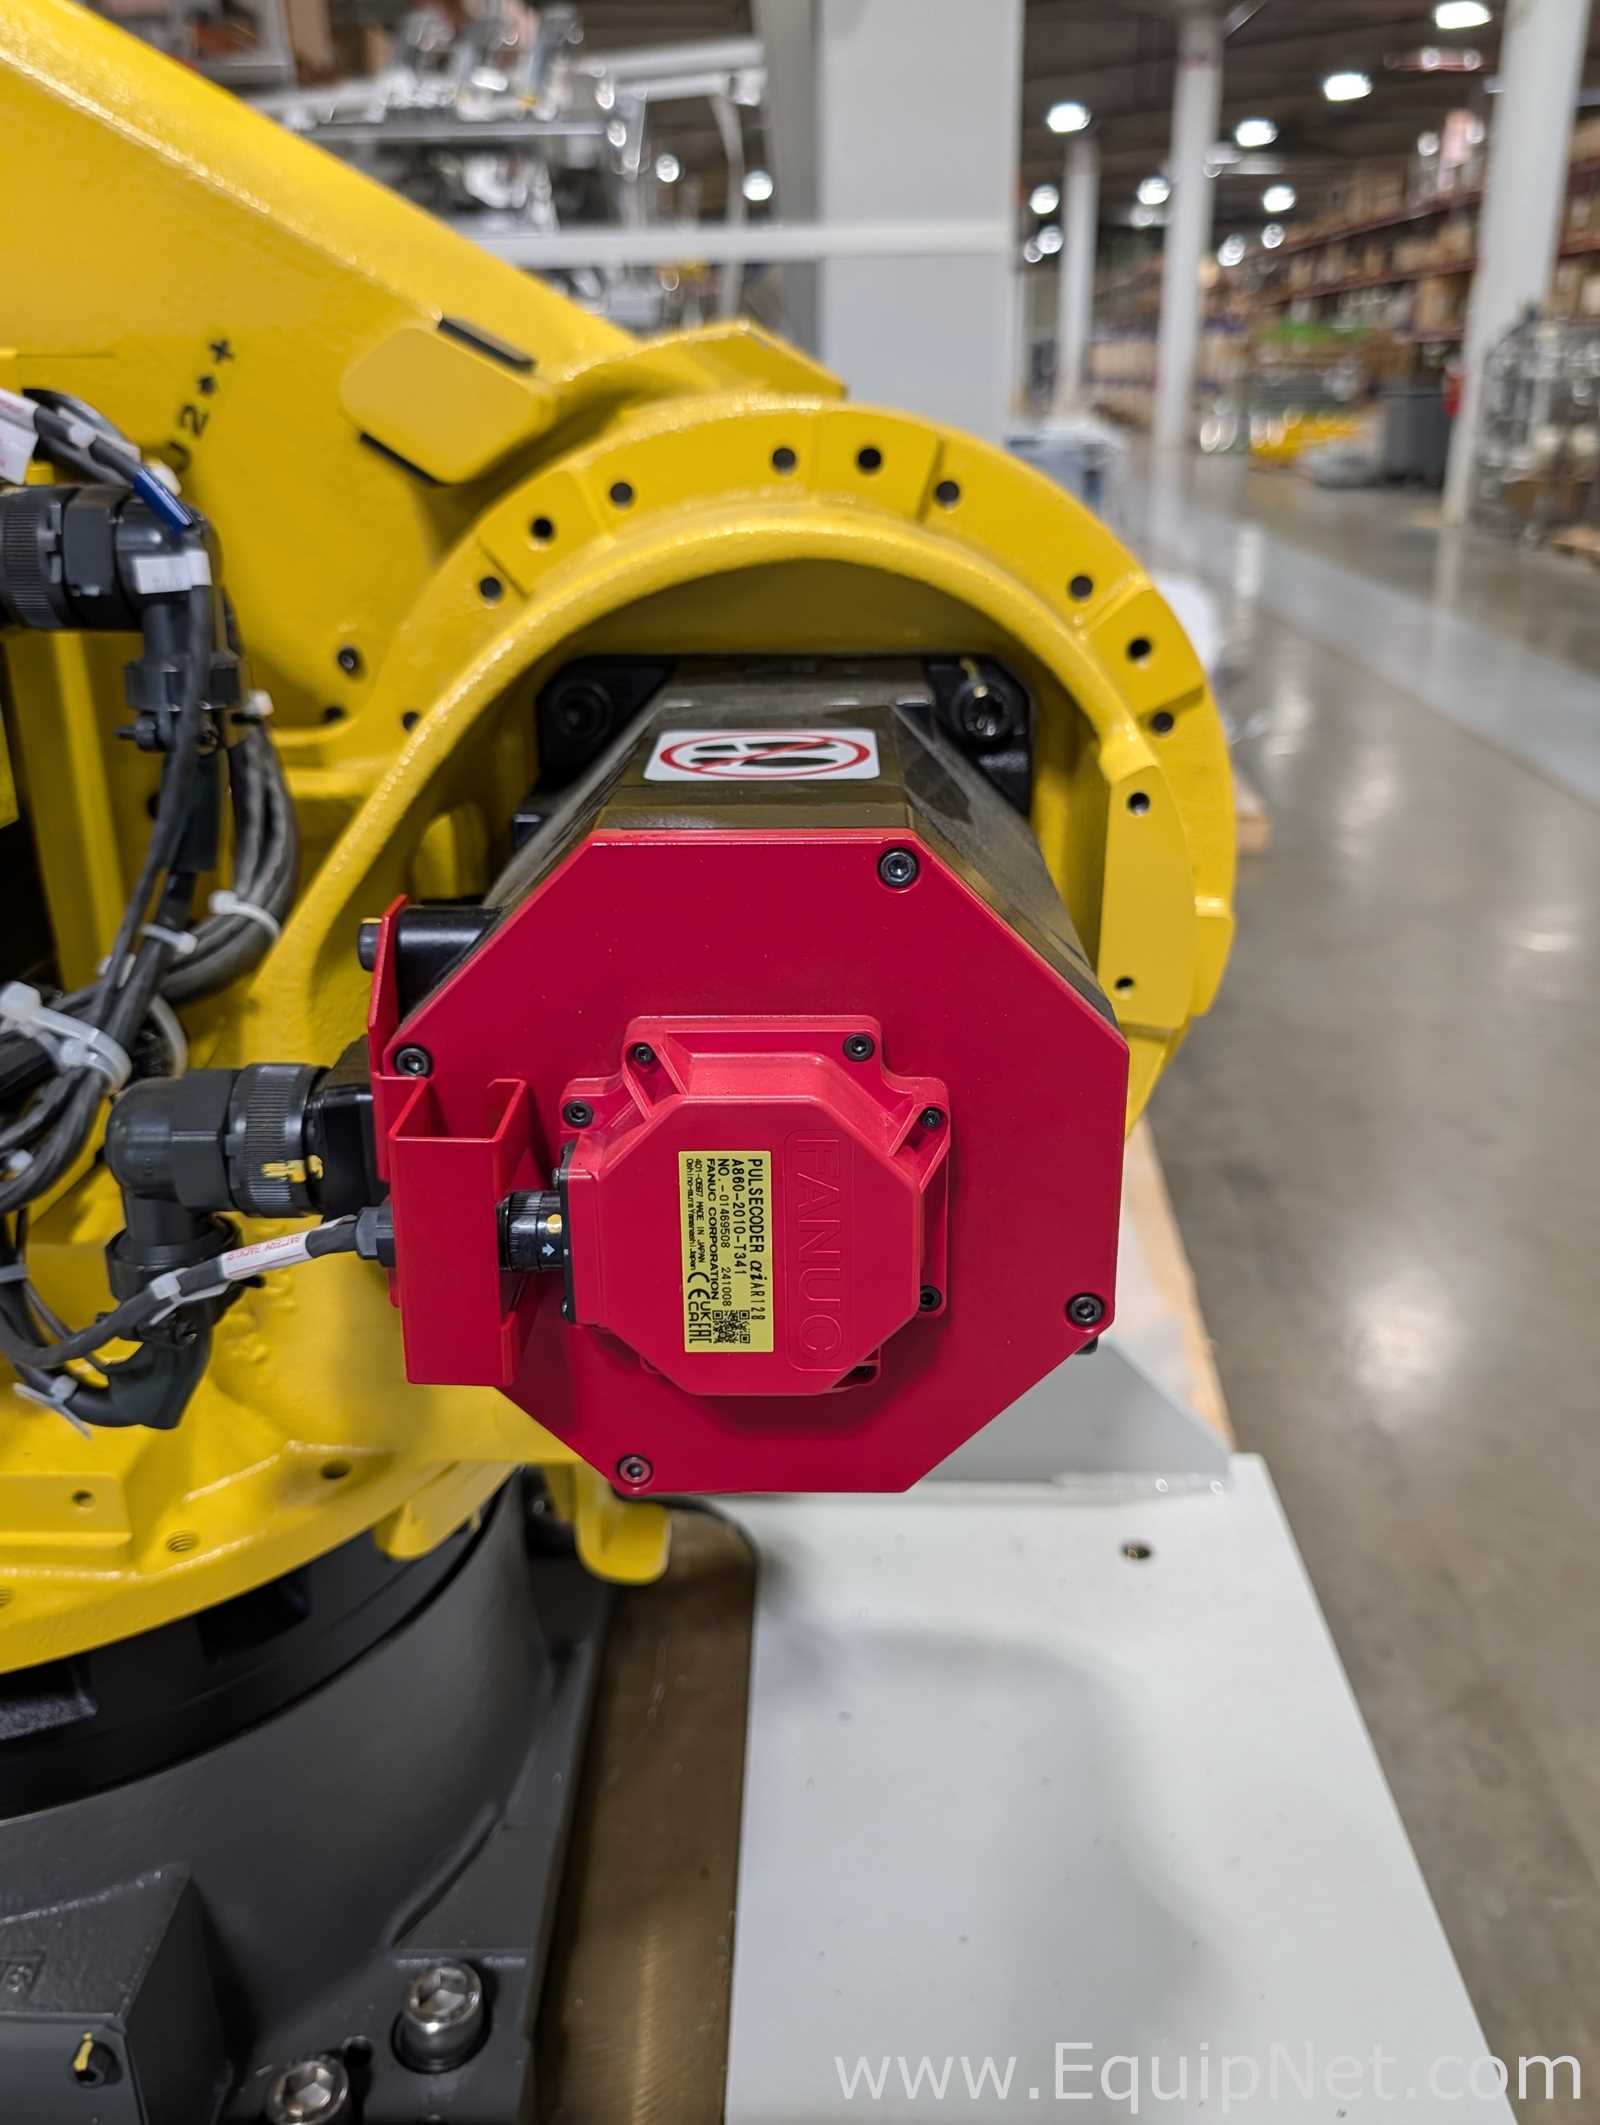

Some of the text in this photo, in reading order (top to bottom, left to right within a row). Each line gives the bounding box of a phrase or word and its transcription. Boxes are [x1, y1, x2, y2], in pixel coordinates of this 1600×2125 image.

[695, 1201, 704, 1221] MADE
[696, 1226, 704, 1236] IN
[707, 1159, 719, 1300] FANUC CORPORATION
[732, 1158, 748, 1275] A860-2010-T341
[748, 1159, 764, 1253] PULSECODER
[697, 1239, 705, 1263] JAPAN
[797, 1138, 842, 1352] FANUC
[721, 1267, 732, 1307] 241008
